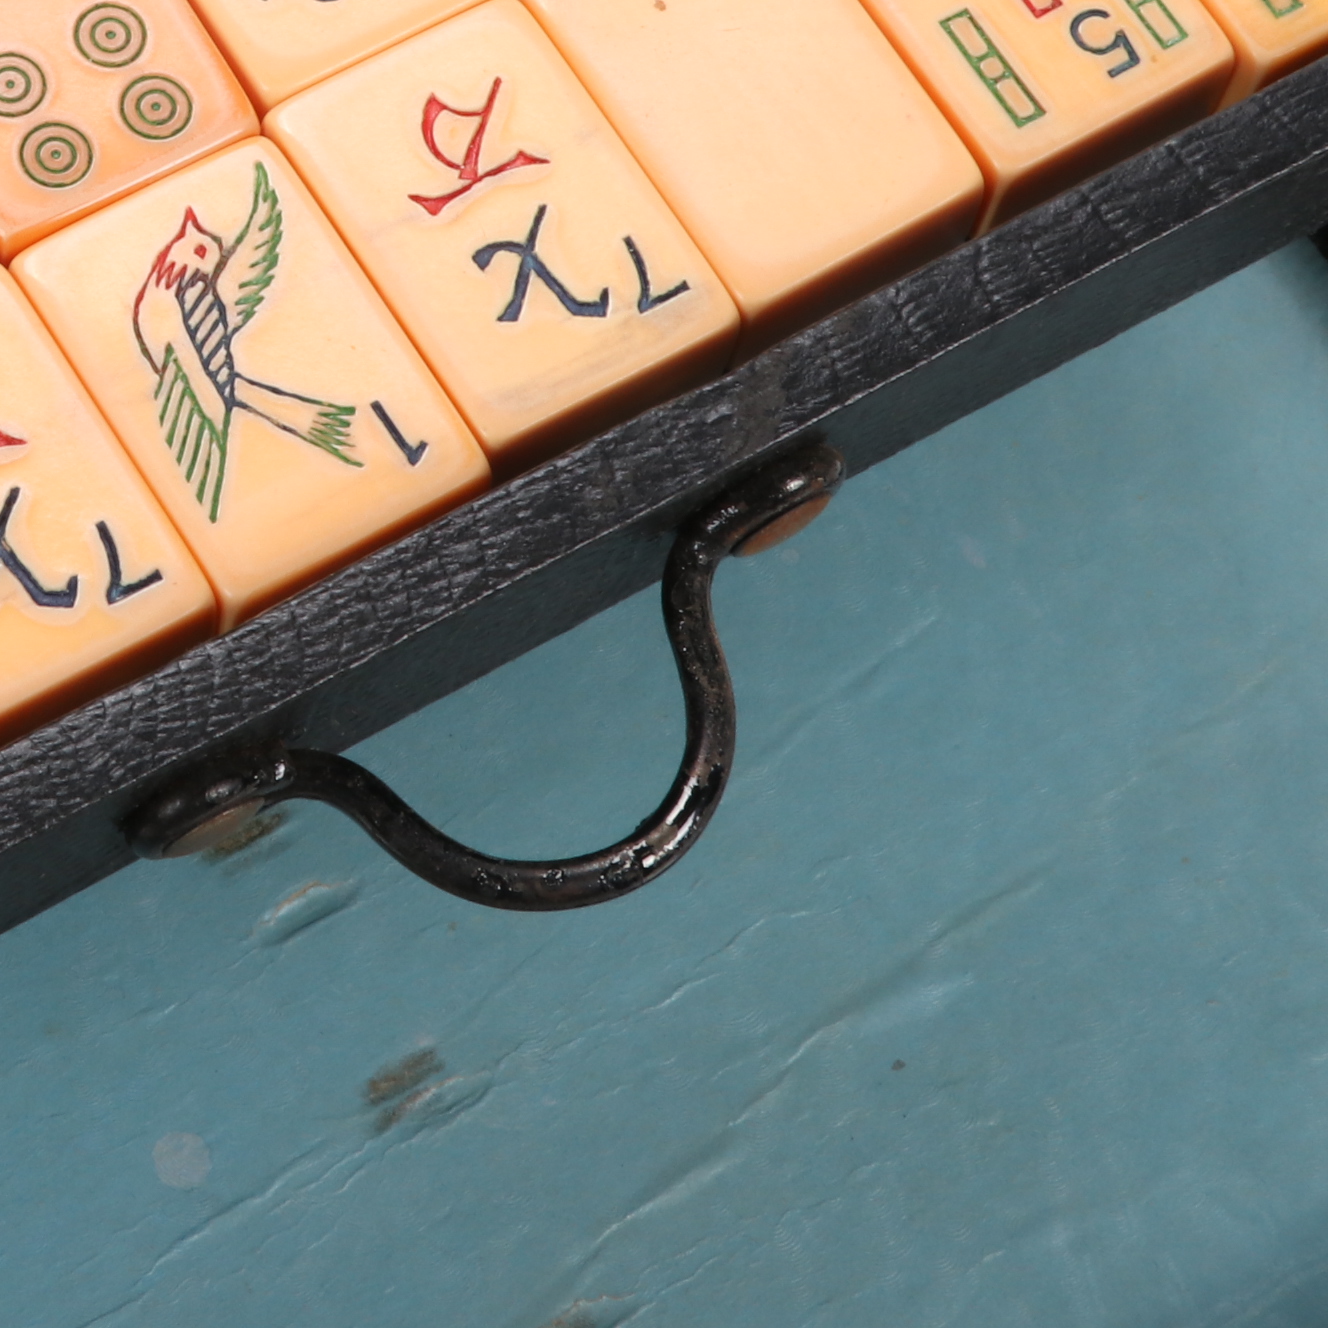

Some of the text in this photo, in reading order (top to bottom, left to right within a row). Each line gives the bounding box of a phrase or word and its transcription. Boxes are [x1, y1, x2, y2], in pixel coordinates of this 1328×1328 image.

[1069, 7, 1142, 79] 5
[623, 236, 690, 314] 7
[370, 400, 428, 466] 1
[95, 520, 163, 605] 7
